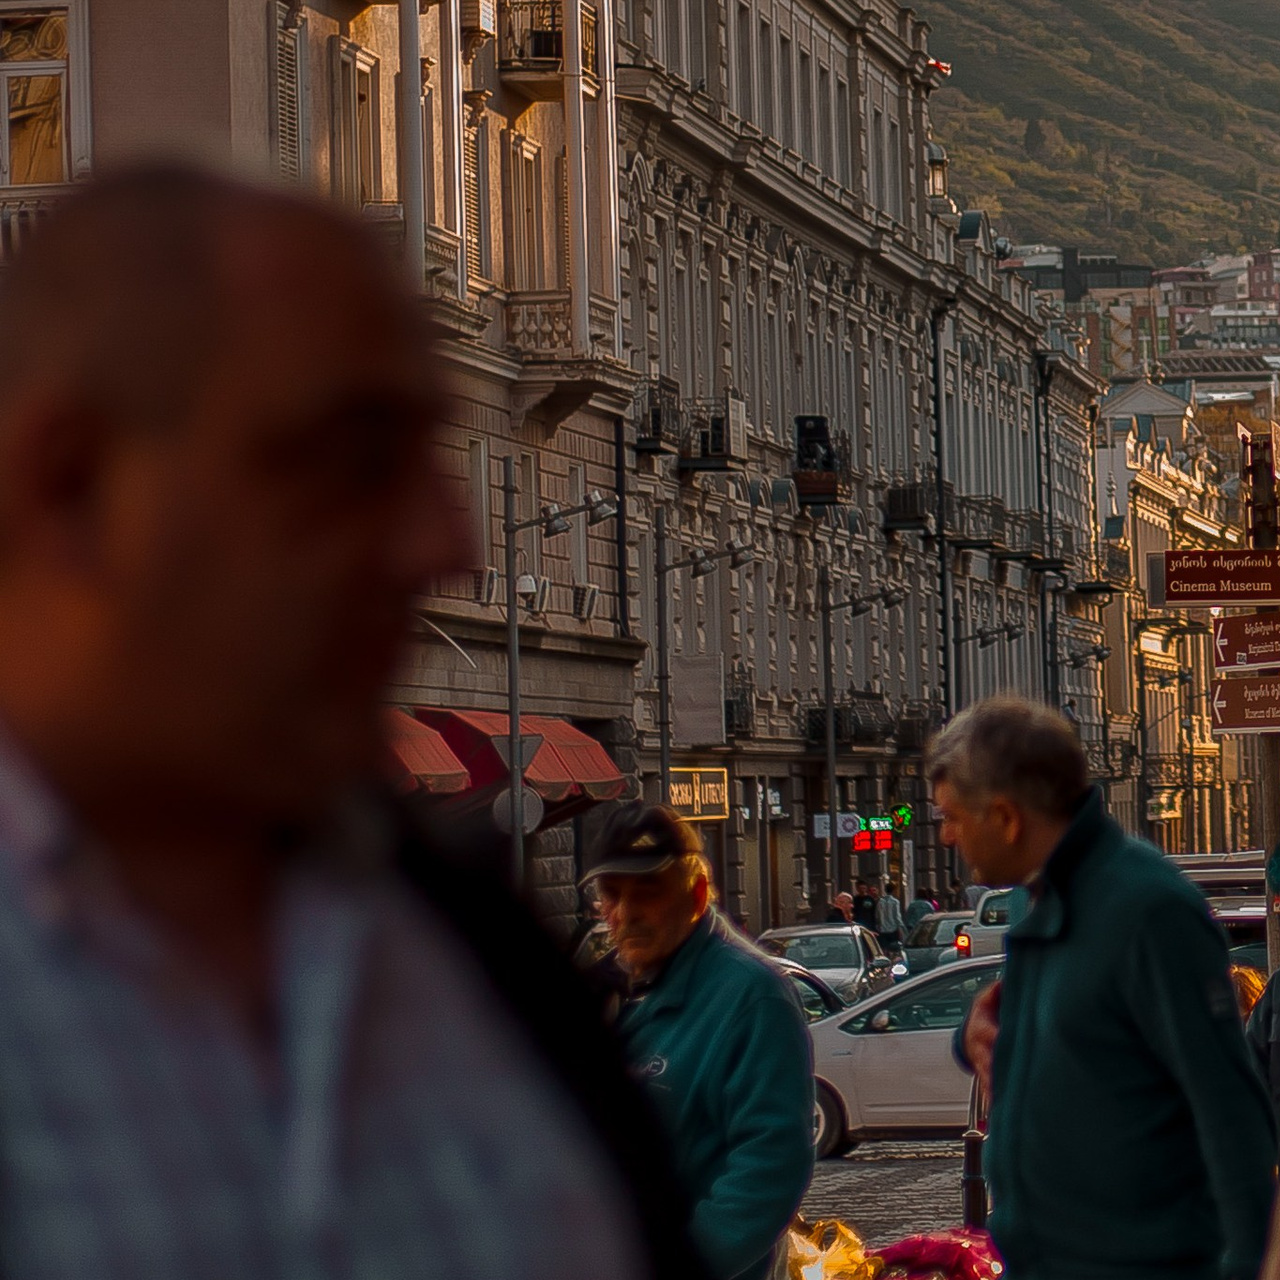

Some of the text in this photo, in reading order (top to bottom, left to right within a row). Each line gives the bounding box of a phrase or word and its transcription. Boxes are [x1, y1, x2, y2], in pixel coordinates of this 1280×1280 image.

[1169, 555, 1207, 572] კინოს
[1169, 580, 1272, 592] Cinema Museum
